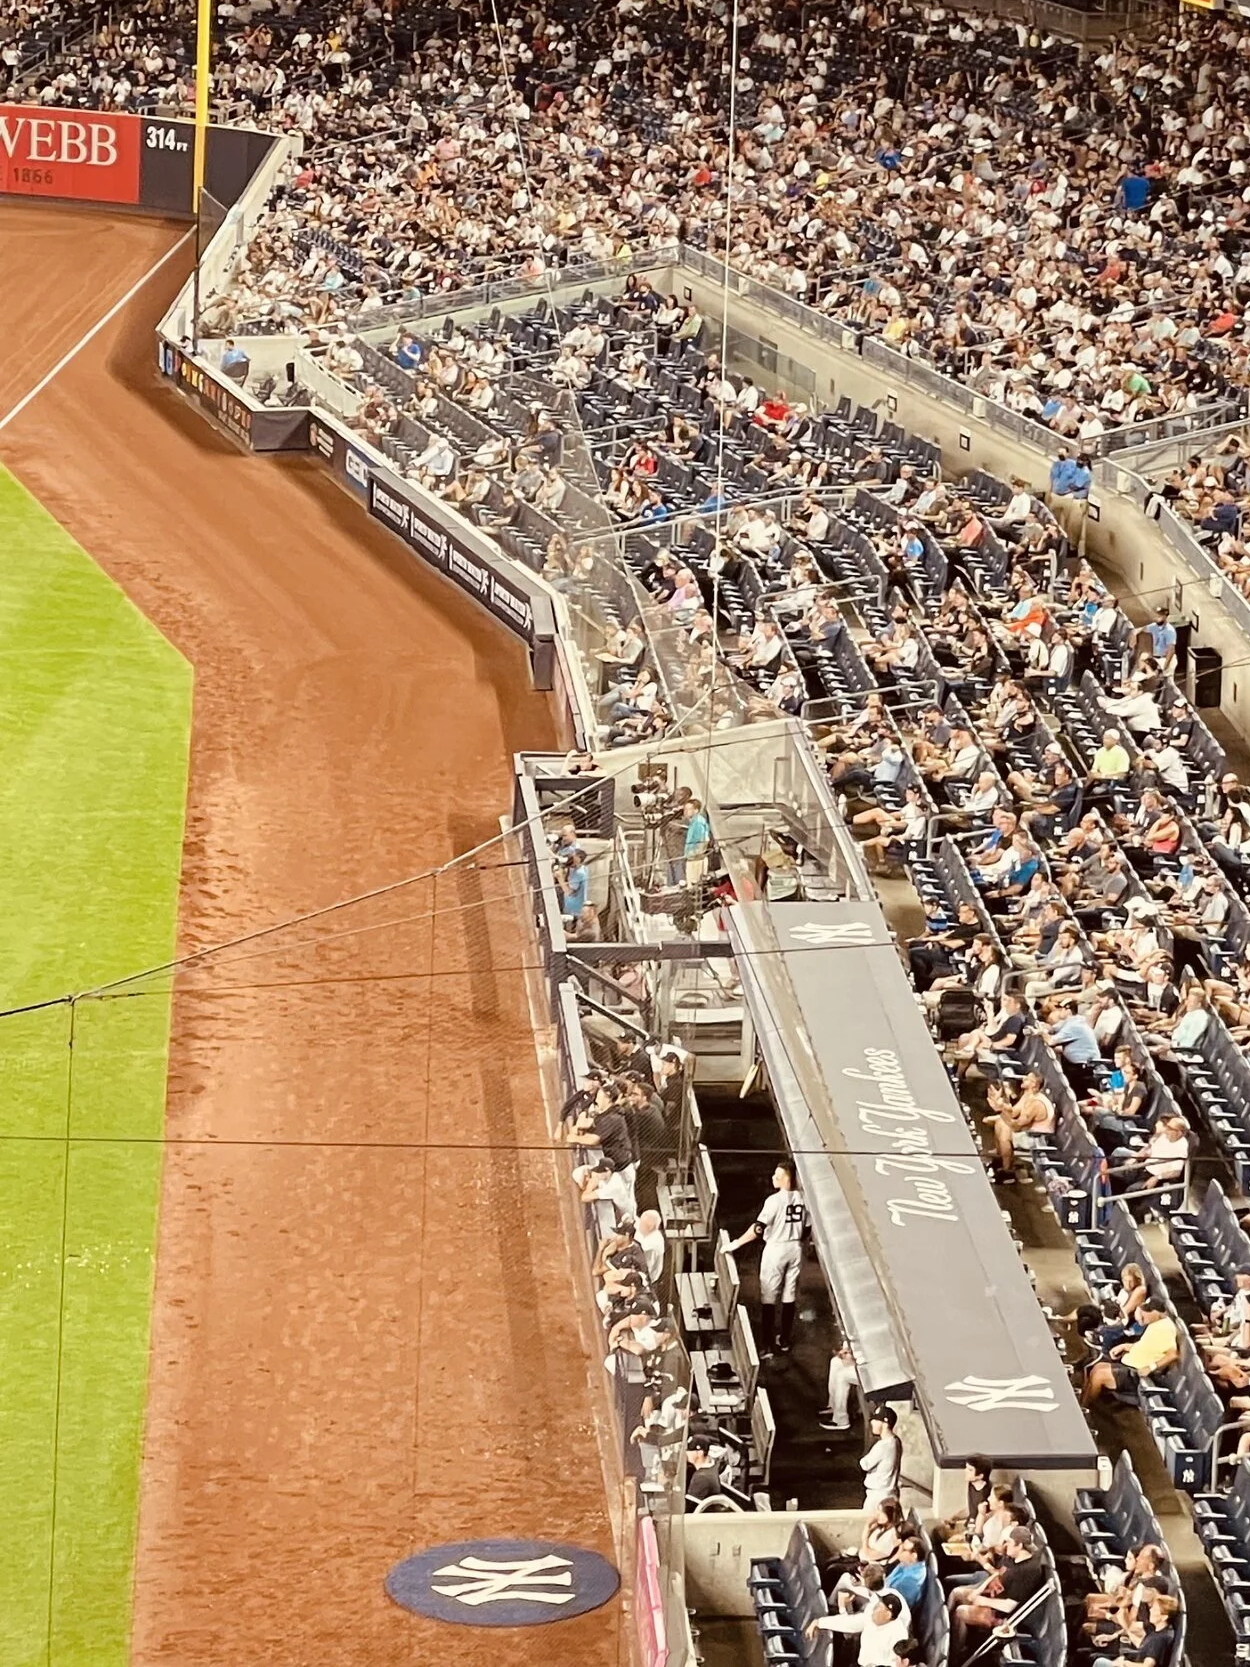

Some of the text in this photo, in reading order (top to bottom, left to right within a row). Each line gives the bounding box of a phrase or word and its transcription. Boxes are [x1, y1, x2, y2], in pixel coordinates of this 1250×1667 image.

[146, 125, 176, 151] 314
[13, 168, 54, 184] 1866
[842, 1047, 976, 1226] New York Yankees
[785, 1204, 803, 1223] 99
